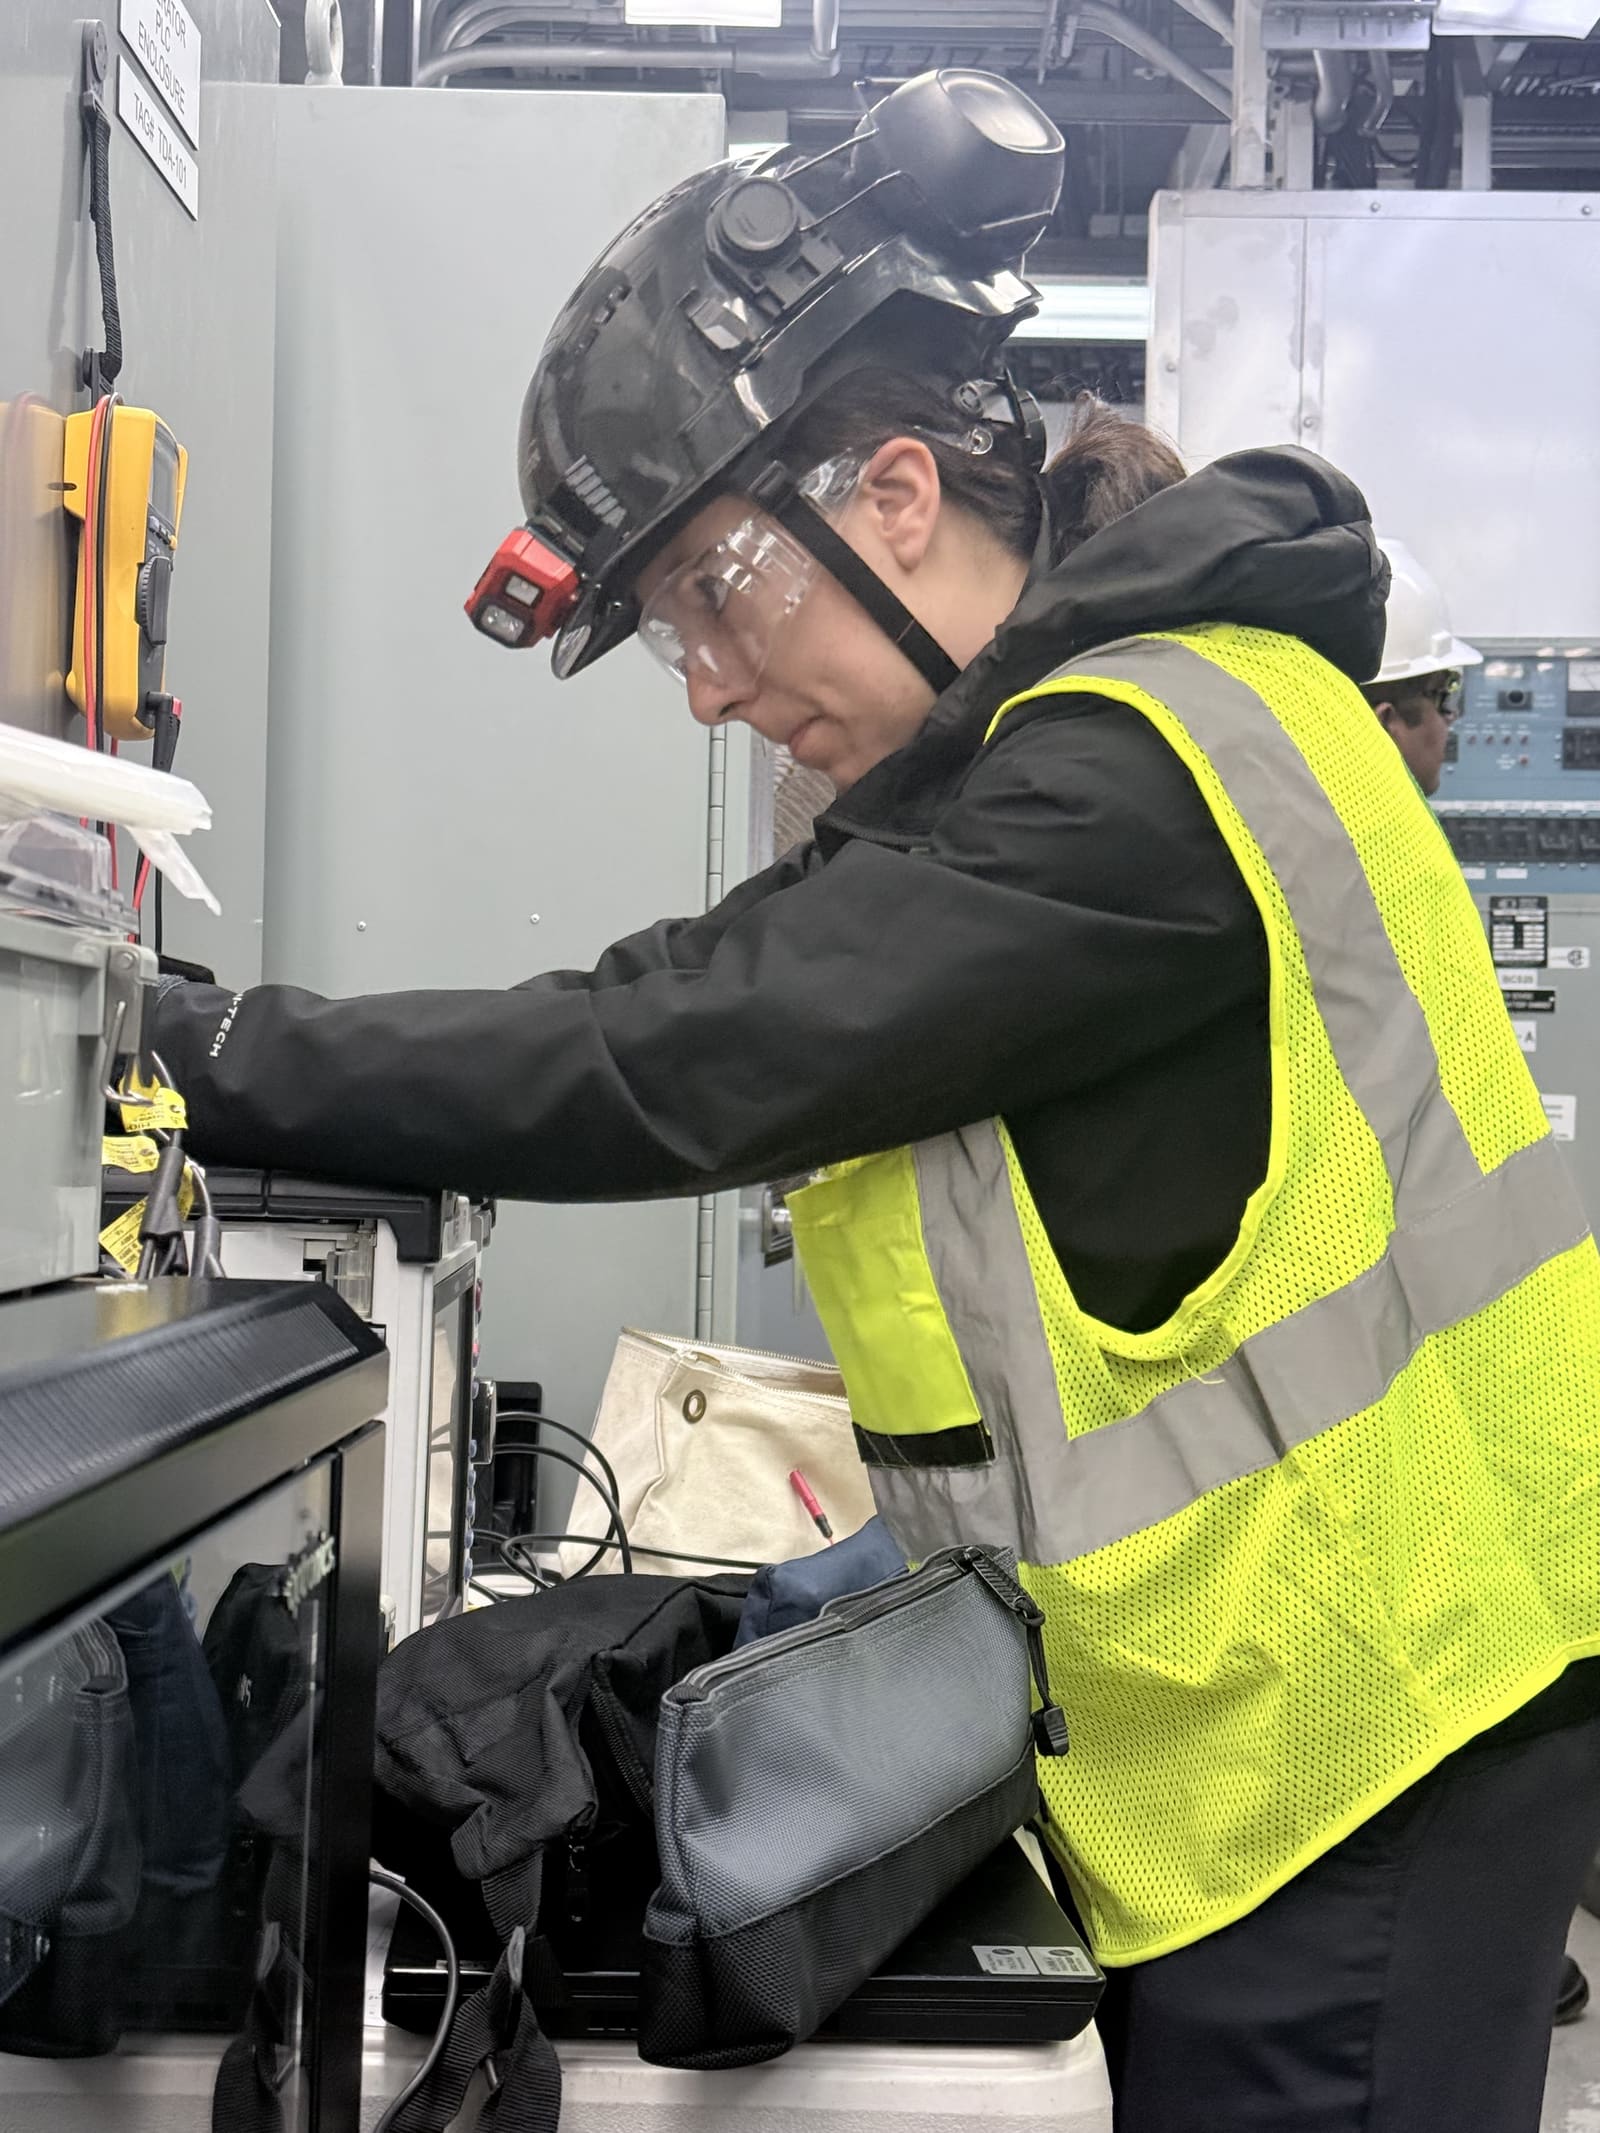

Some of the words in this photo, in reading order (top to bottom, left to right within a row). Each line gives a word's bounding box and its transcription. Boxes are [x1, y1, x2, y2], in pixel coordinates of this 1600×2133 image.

[139, 20, 185, 115] ENCLOSURE
[156, 9, 171, 52] PLC
[134, 92, 155, 142] TAG#
[158, 126, 187, 189] TDA-101
